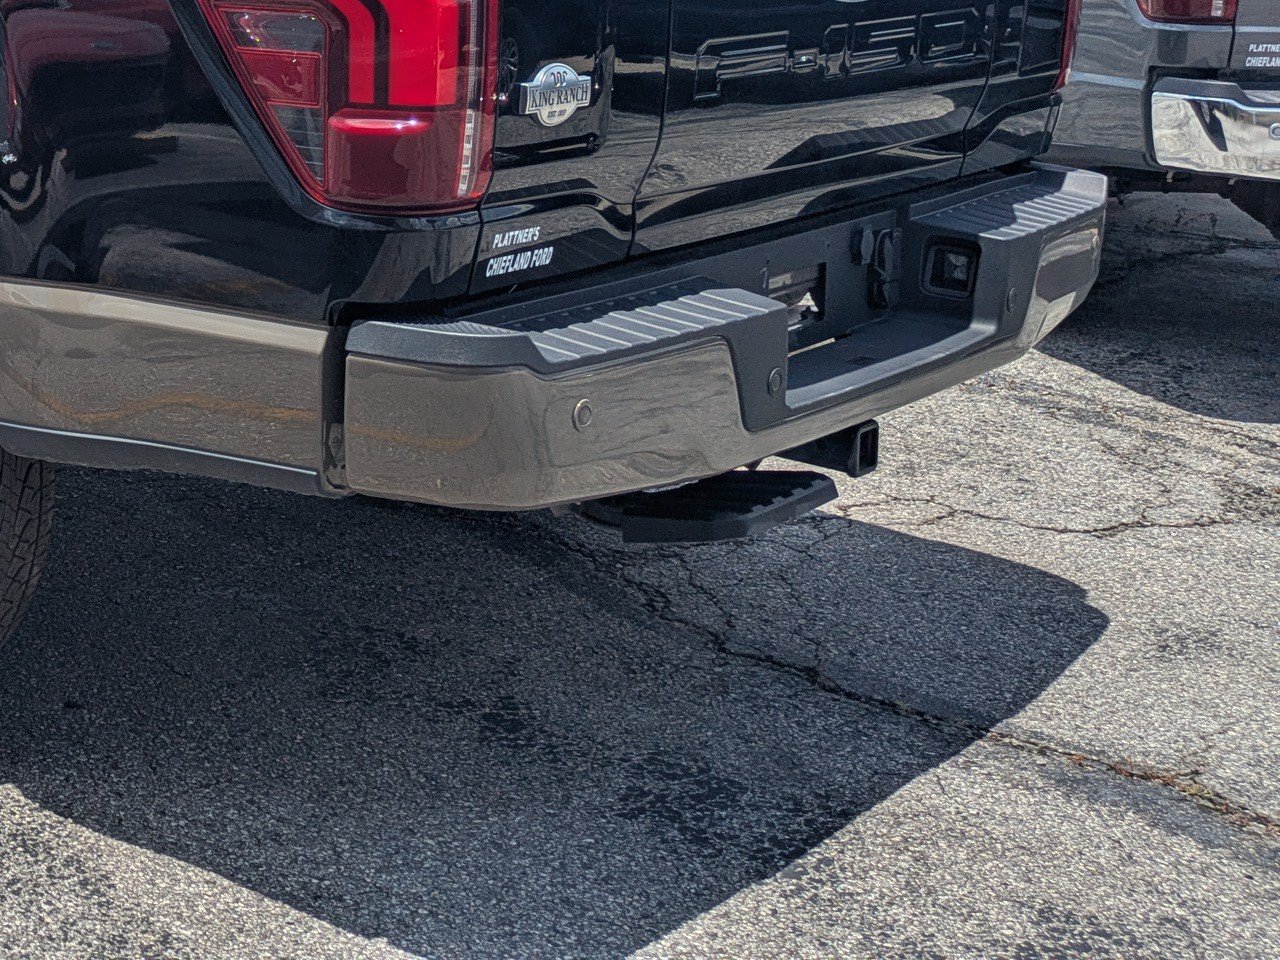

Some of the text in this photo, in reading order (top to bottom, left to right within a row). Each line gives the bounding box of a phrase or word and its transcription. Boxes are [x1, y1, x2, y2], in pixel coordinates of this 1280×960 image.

[531, 83, 589, 108] KING RANCH
[493, 226, 540, 249] PLATTNER'S
[486, 246, 554, 277] CHIEFLAND FORD
